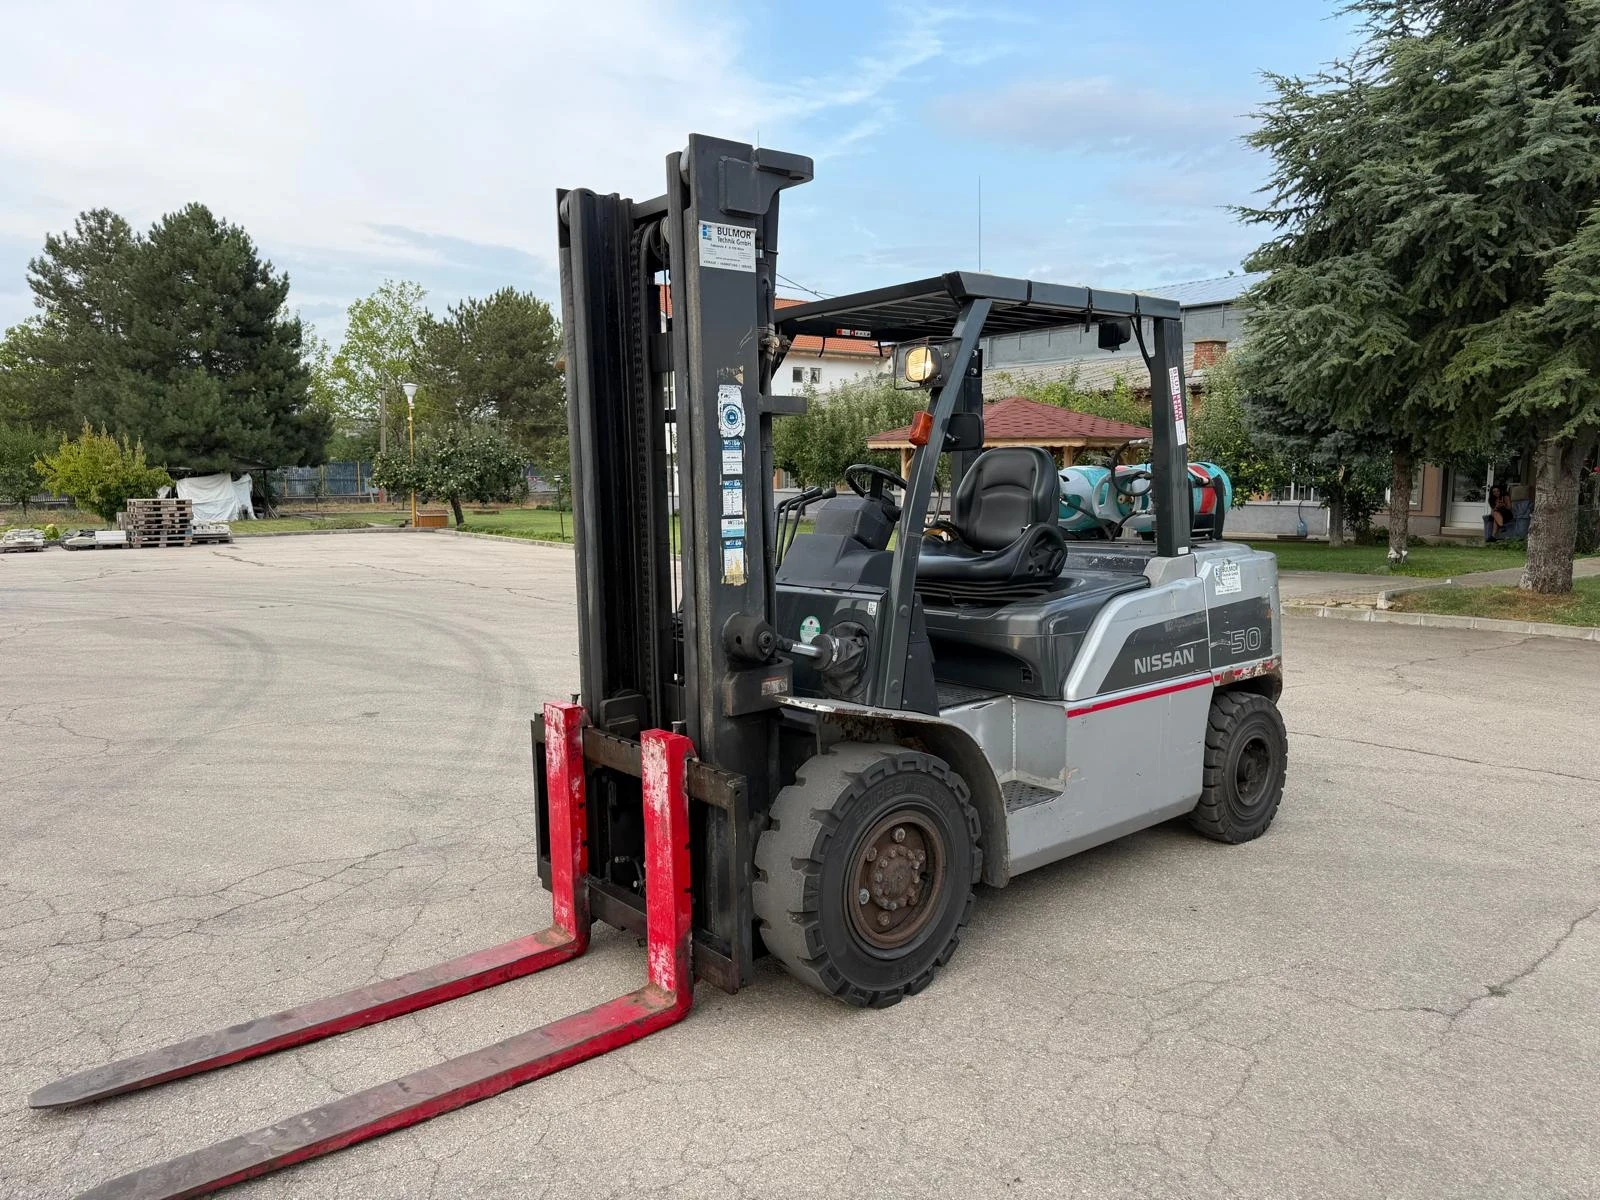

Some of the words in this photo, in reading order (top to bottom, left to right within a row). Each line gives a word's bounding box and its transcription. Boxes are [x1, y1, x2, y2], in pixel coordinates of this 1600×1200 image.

[717, 226, 751, 239] BULMOR
[1231, 627, 1261, 654] 50
[1134, 647, 1194, 675] NISSAN
